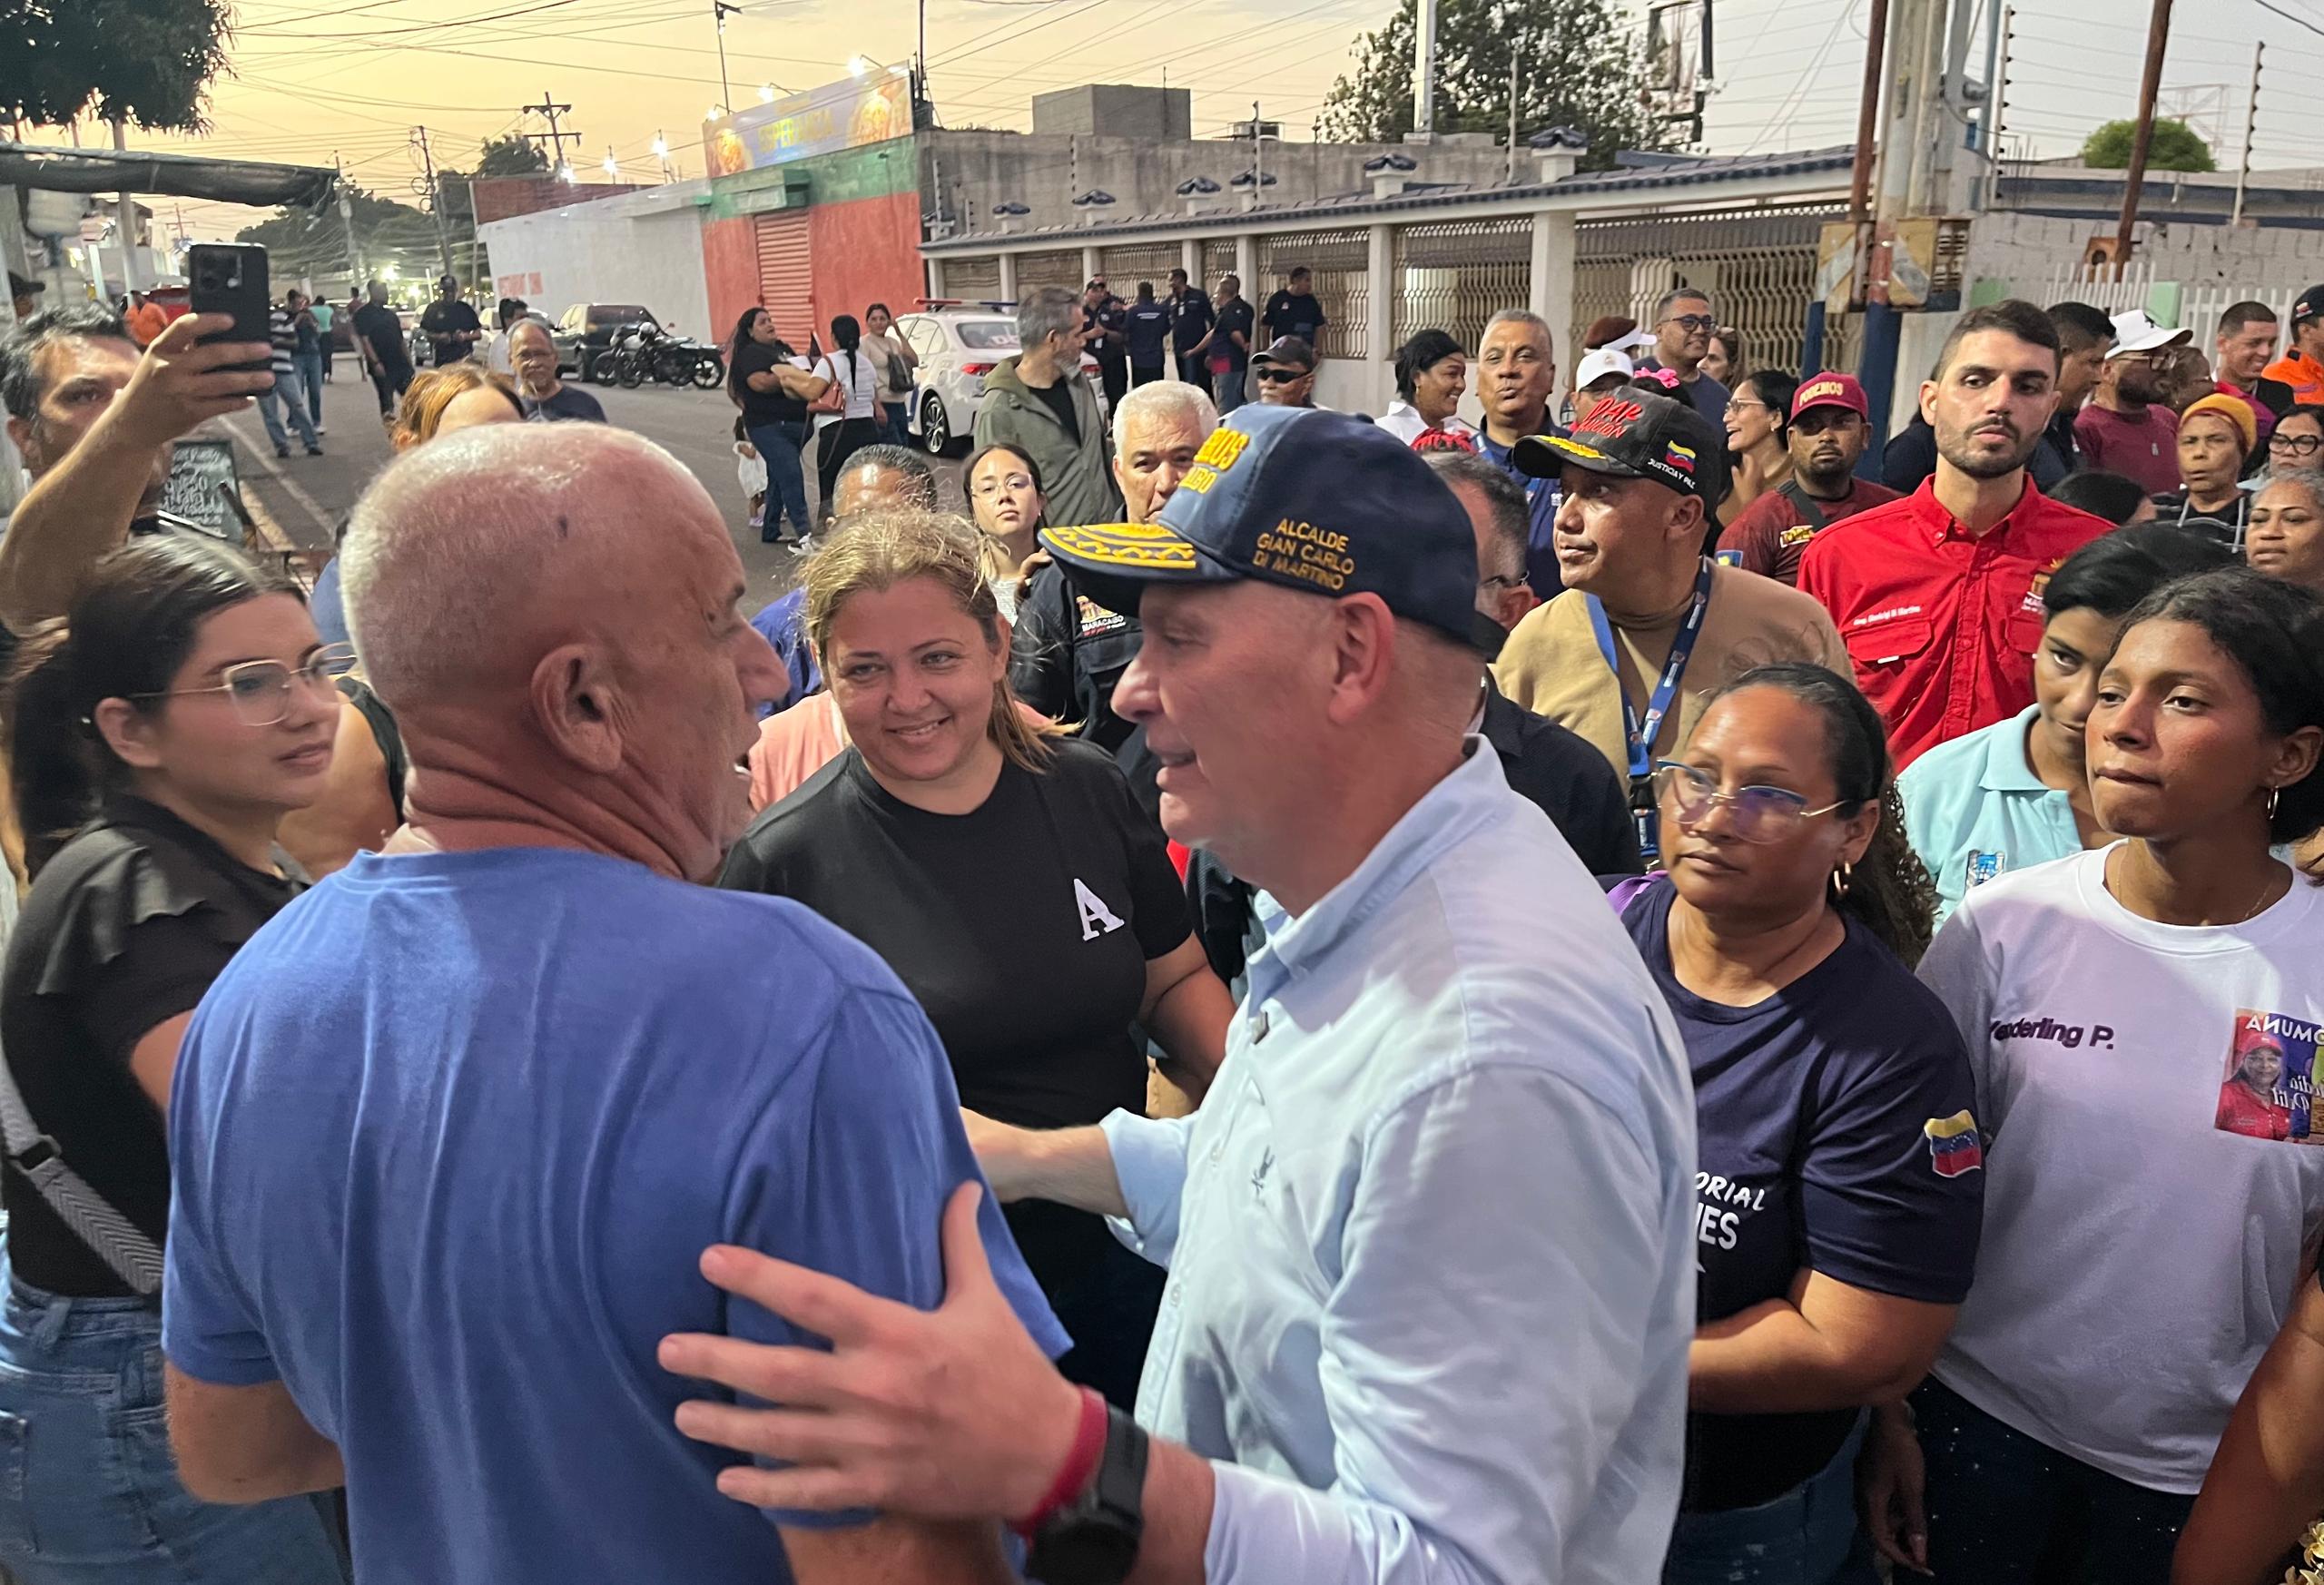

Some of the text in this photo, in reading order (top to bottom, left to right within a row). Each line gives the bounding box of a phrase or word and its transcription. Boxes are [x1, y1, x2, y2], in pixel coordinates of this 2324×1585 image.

[1256, 532, 1354, 575] GIAN CARLO
[1275, 517, 1349, 552] ALCALDE
[1253, 550, 1344, 590] DI MARTINO
[1073, 878, 1125, 941] A
[2089, 1025, 2114, 1049] P.
